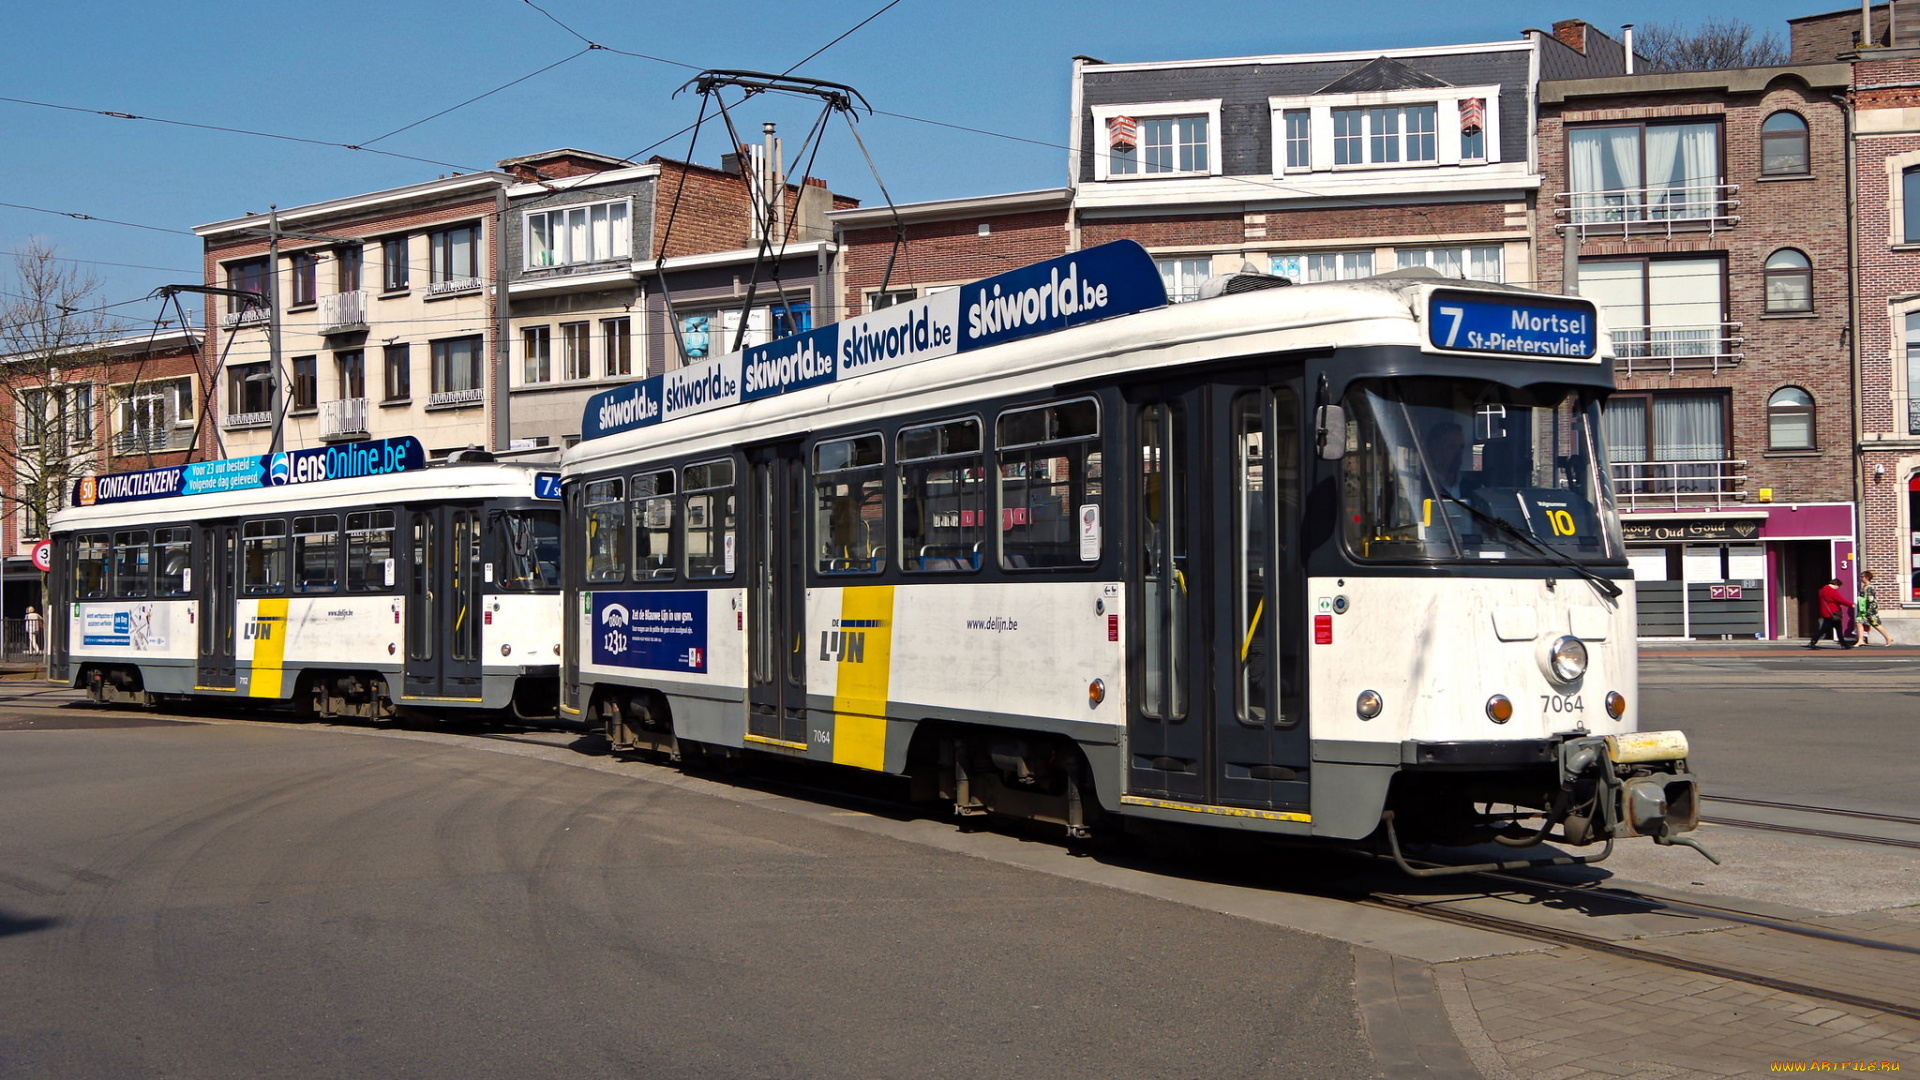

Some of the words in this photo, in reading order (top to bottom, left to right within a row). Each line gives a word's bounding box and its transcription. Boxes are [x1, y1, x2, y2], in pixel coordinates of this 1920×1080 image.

[968, 261, 1107, 339] skiworld.be
[1440, 306, 1464, 347] 7
[1512, 310, 1586, 335] Mortsel
[843, 305, 951, 369] skiworld.be
[746, 337, 832, 393] skiworld.be
[667, 363, 736, 412] skiworld.be
[599, 385, 658, 430] skiworld.be
[207, 463, 214, 475] 23
[227, 458, 250, 473] besteld
[83, 482, 93, 499] 50
[98, 469, 180, 499] CONTACTLENZEN?
[189, 475, 216, 493] Volgende
[218, 475, 229, 490] dag
[230, 471, 258, 489] geleverd
[541, 476, 553, 495] 7
[1546, 510, 1576, 536] 10
[1621, 523, 1651, 536] koop
[1655, 527, 1684, 540] Oud
[1689, 521, 1727, 535] Goud
[1841, 560, 1848, 569] 3
[608, 613, 623, 627] 0800
[832, 619, 840, 627] DE
[966, 616, 1018, 633] www.delijn.be
[604, 629, 627, 655] 12312
[820, 630, 865, 663] LIJN
[1540, 694, 1585, 713] 7064
[813, 729, 830, 744] 7064
